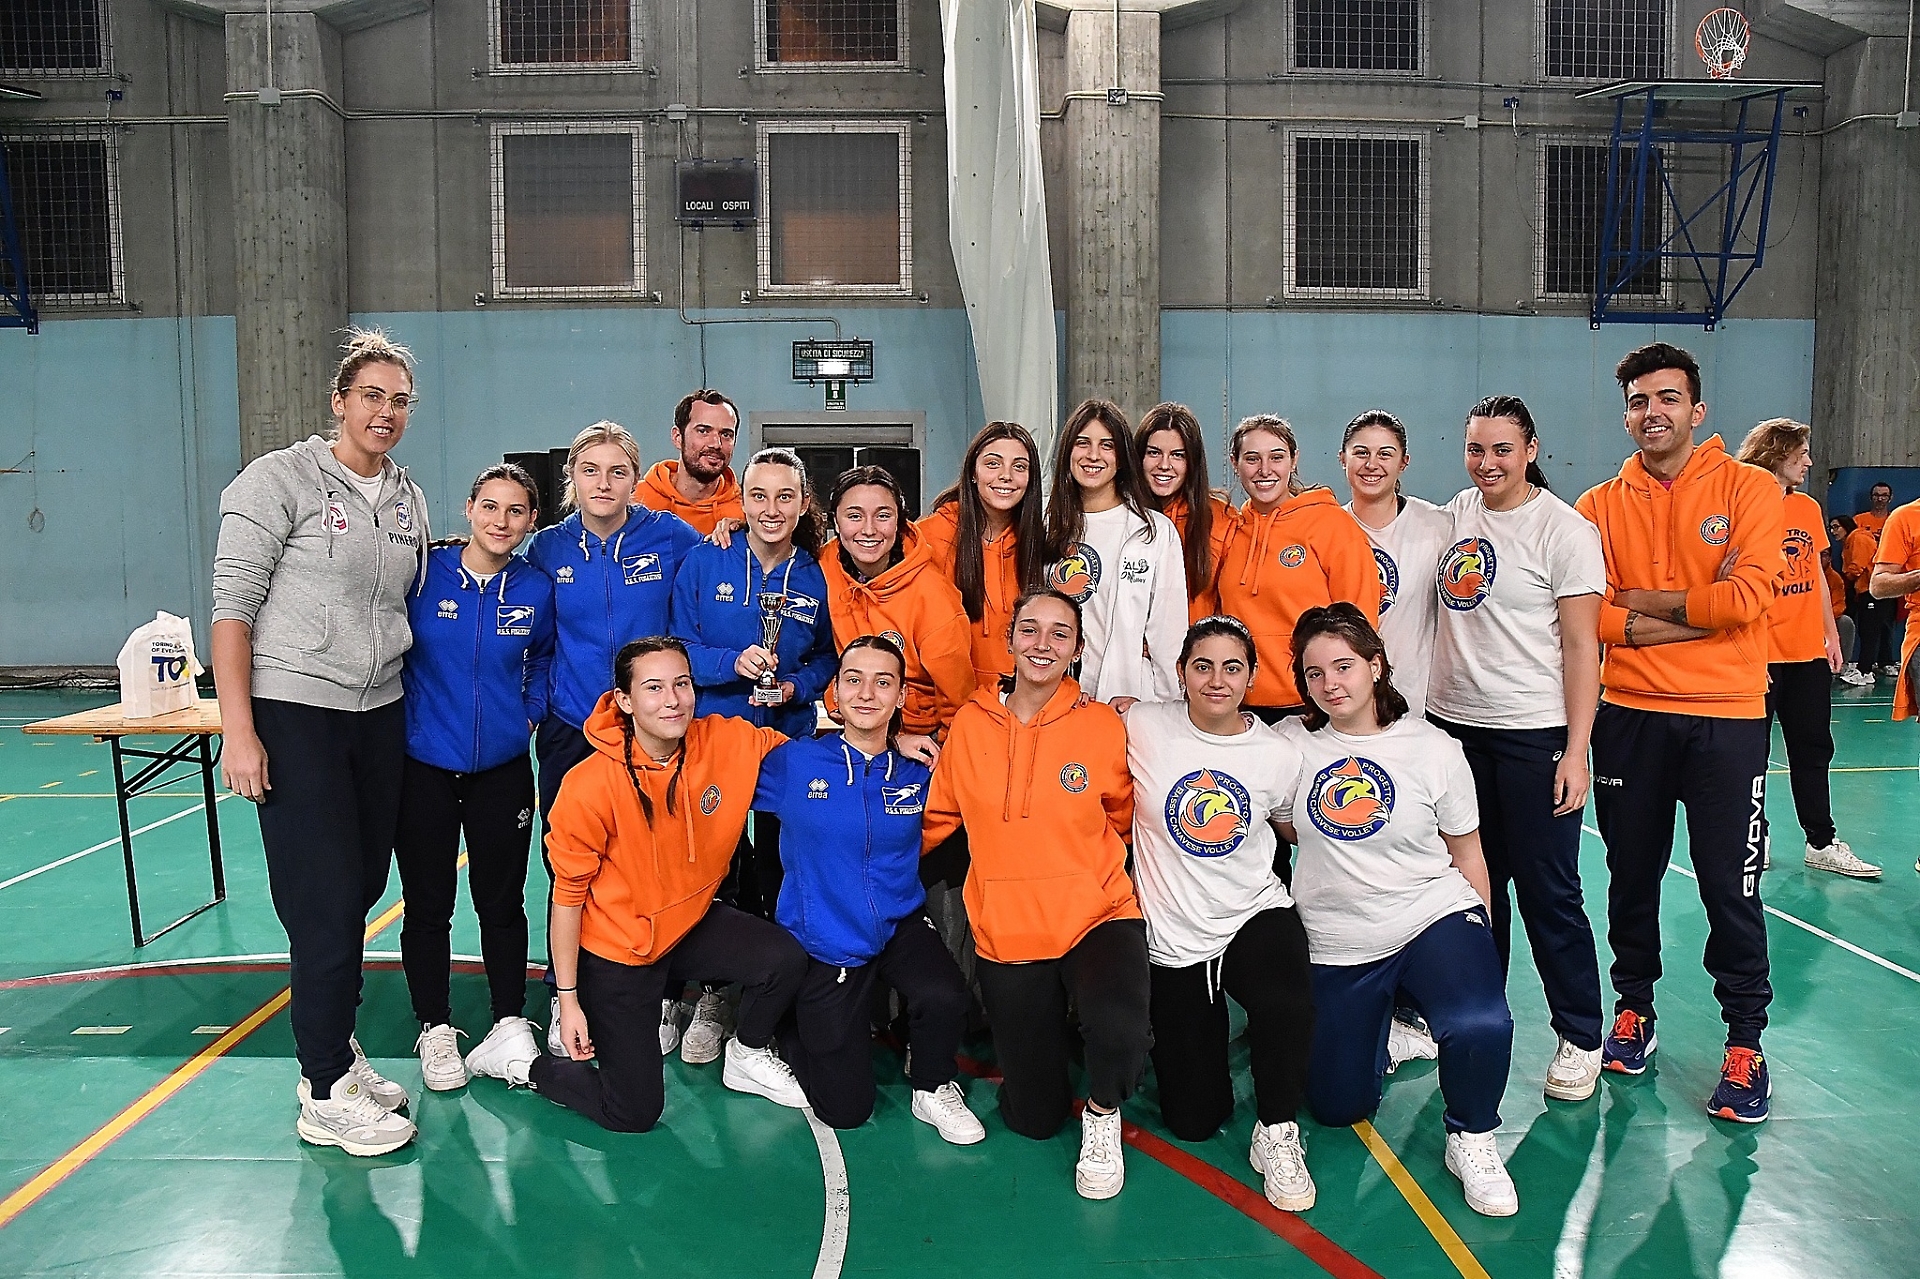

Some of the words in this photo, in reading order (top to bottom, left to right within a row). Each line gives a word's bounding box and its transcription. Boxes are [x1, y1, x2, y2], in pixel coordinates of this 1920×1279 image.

[685, 201, 714, 210] LOCALI
[722, 201, 750, 210] OSPITI
[1374, 551, 1397, 588] PROGETTO
[1479, 542, 1494, 579] PROGETTO
[151, 655, 187, 682] TO
[1168, 785, 1185, 815] BASSO
[1217, 775, 1250, 819] PROGETTO
[1361, 762, 1392, 805] PROGETTO
[1169, 816, 1203, 854] CANAVESE
[1309, 800, 1341, 836] CANAVESE
[1341, 823, 1375, 838] VOLLEY
[1742, 775, 1765, 898] GIVOVA
[1203, 839, 1236, 854] VOLLEY
